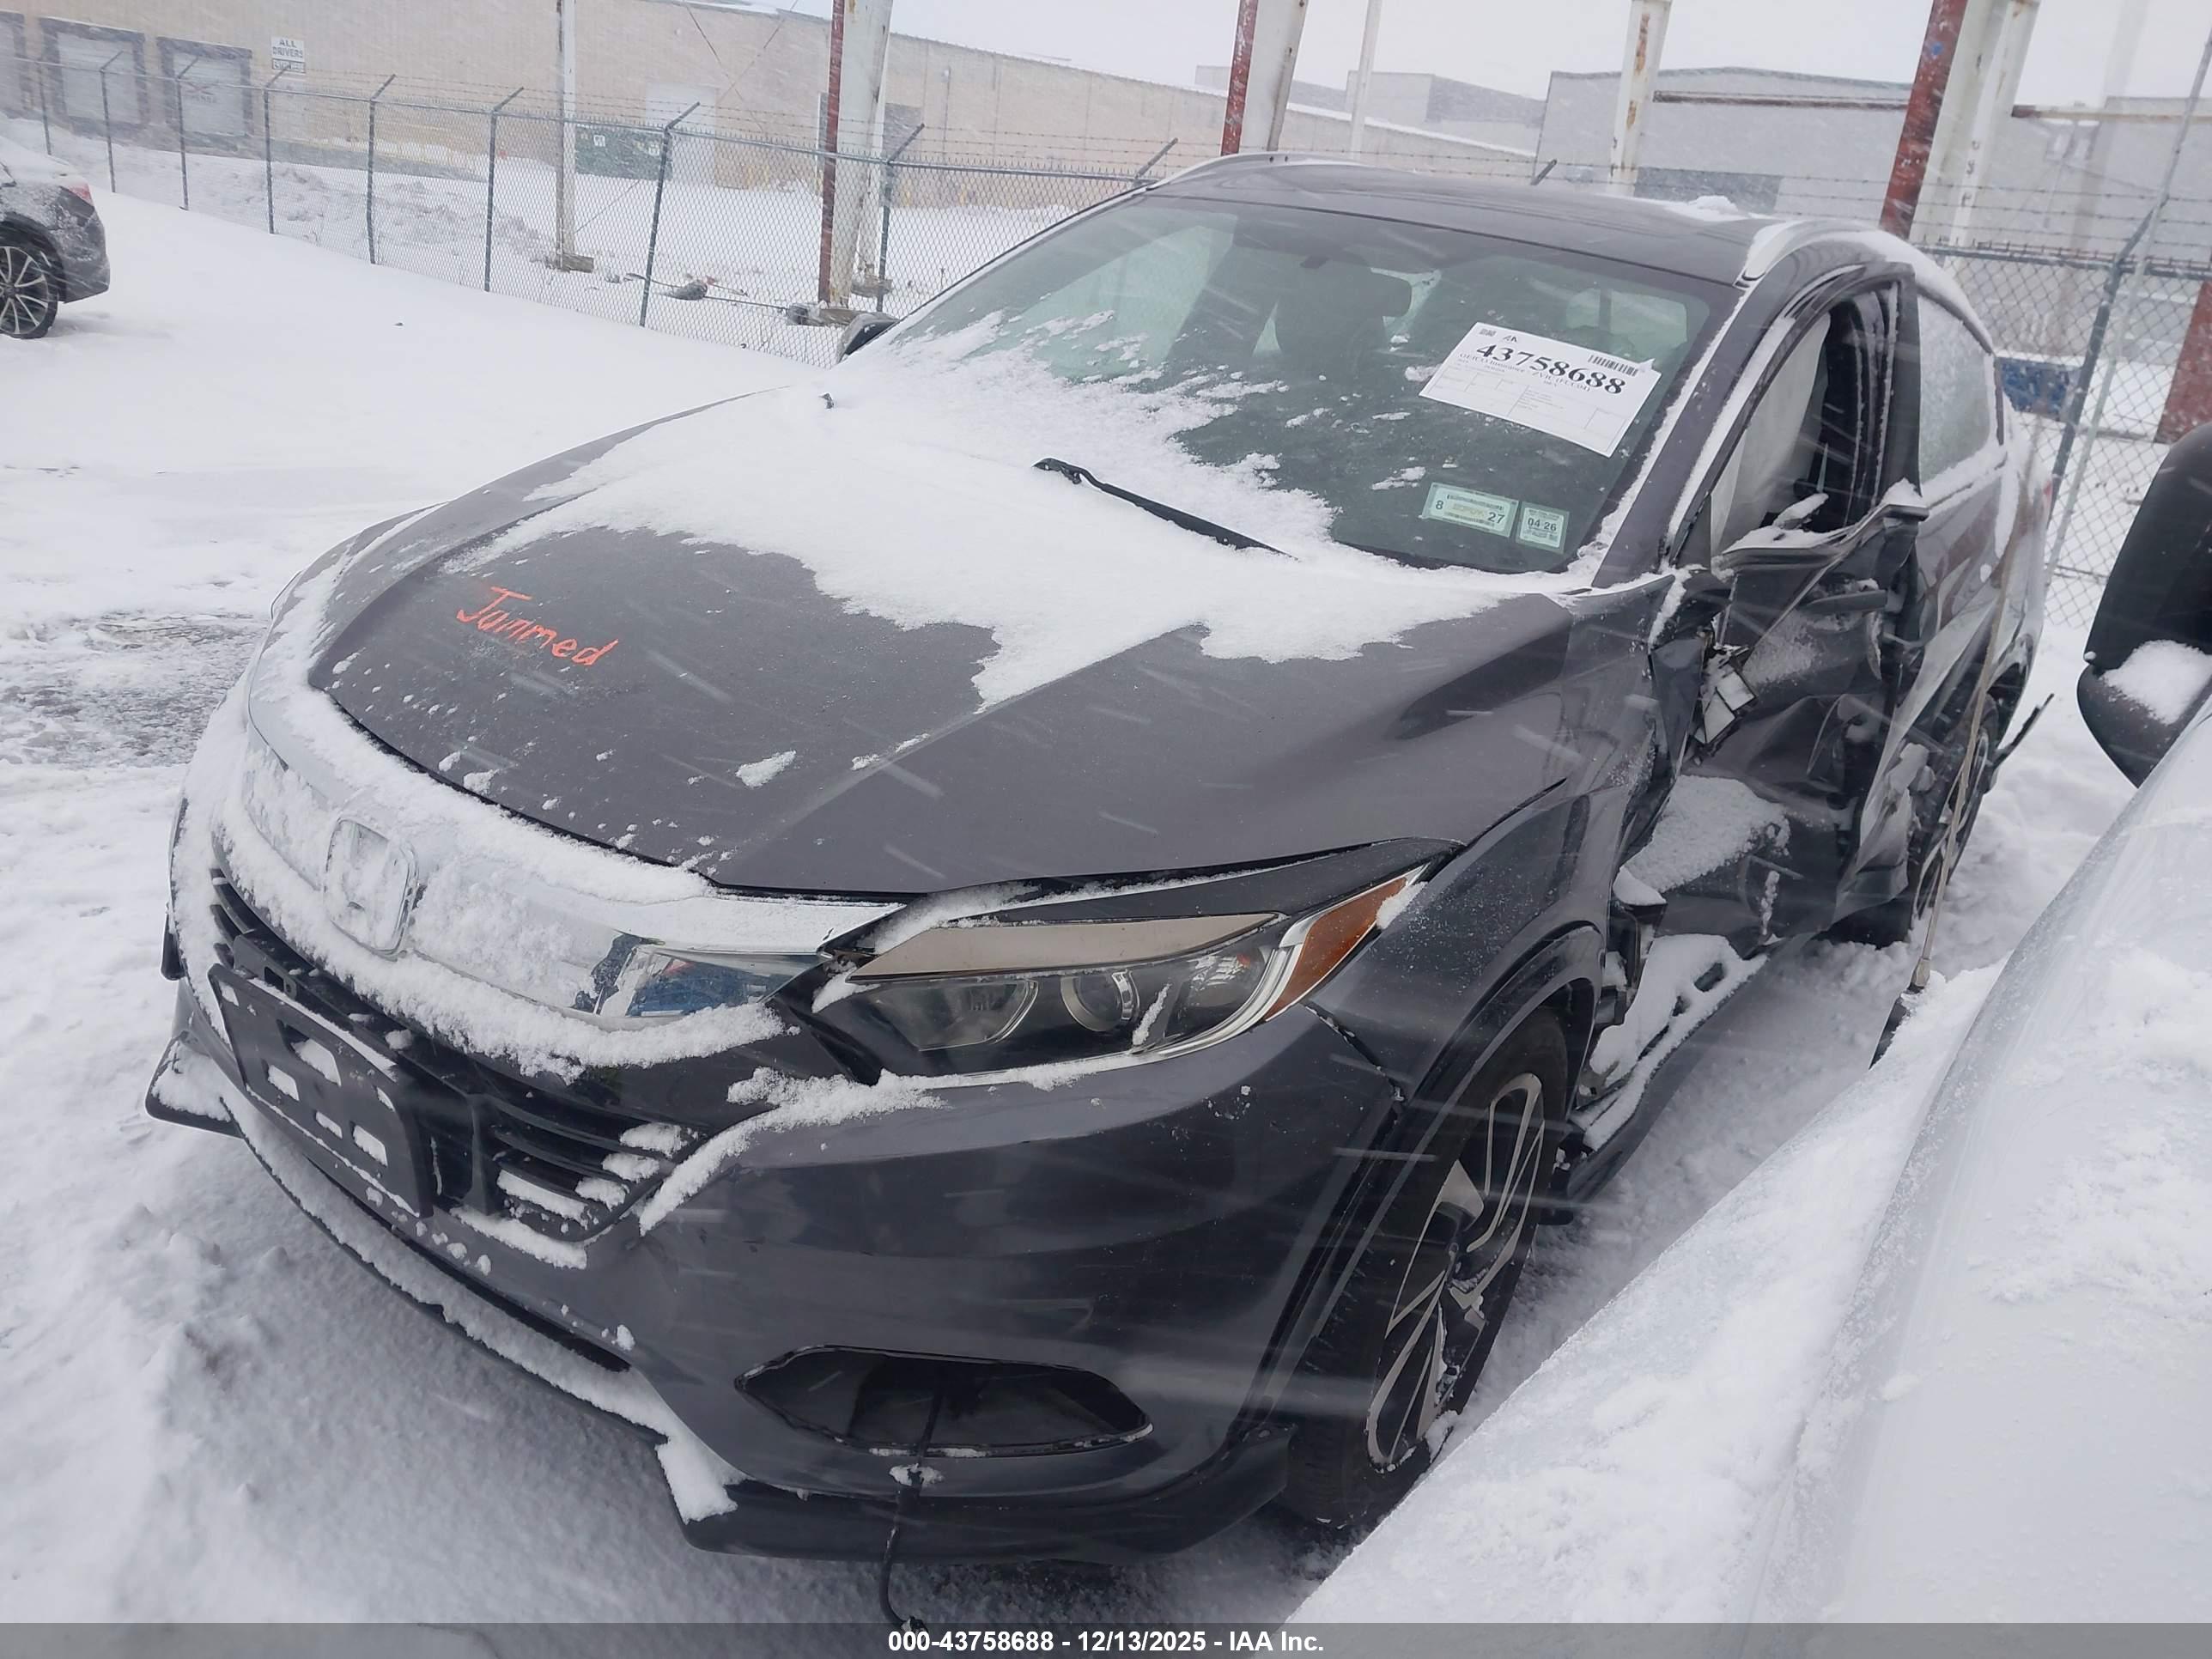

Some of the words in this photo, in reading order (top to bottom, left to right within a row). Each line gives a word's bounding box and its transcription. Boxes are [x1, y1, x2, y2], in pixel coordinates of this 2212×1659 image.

[279, 40, 297, 48] ALL
[272, 46, 303, 58] DRIVERS
[1477, 344, 1626, 395] 43758688
[1435, 500, 1444, 510] 8
[1487, 511, 1505, 524] 27
